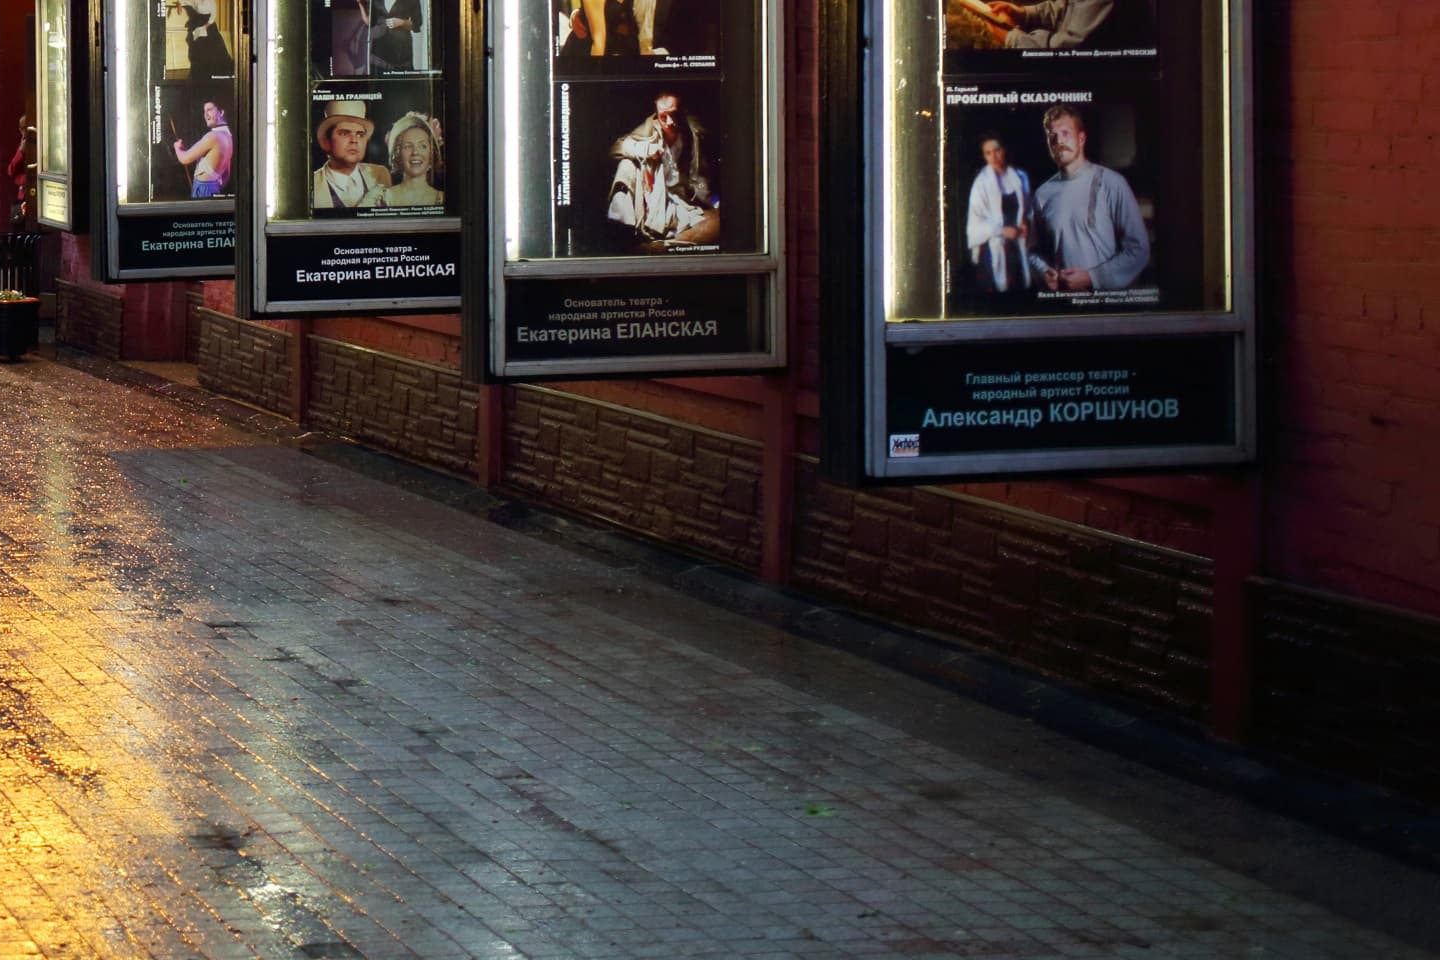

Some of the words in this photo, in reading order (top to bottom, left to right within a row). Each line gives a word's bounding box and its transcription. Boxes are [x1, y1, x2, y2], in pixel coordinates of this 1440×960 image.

[335, 93, 344, 101] ЗА
[946, 92, 1018, 105] ПРОКЛЯТЫЙ
[1020, 91, 1093, 103] СКАЗОЧНИК!
[142, 240, 204, 252] Екатерина
[333, 247, 383, 255] Основатель
[384, 246, 412, 254] театра
[321, 257, 360, 266] народная
[362, 256, 398, 265] артистка
[400, 254, 430, 262] России
[296, 269, 371, 283] Екатерина
[375, 263, 455, 279] ЕЛАНСКАЯ
[564, 298, 626, 308] Основатель
[628, 297, 663, 307] театра
[548, 311, 598, 322] народная
[600, 310, 645, 321] артистка
[648, 308, 686, 318] России
[517, 326, 611, 344] Екатерина
[616, 320, 718, 339] ЕЛАНСКАЯ
[965, 371, 1021, 385] Главный
[1024, 371, 1085, 384] режиссер
[1087, 370, 1128, 382] театра
[972, 387, 1038, 401] народный
[1040, 387, 1081, 400] артист
[1085, 384, 1130, 396] России
[922, 408, 1043, 428] Александр
[1050, 399, 1179, 423] КОРШУНОВ
